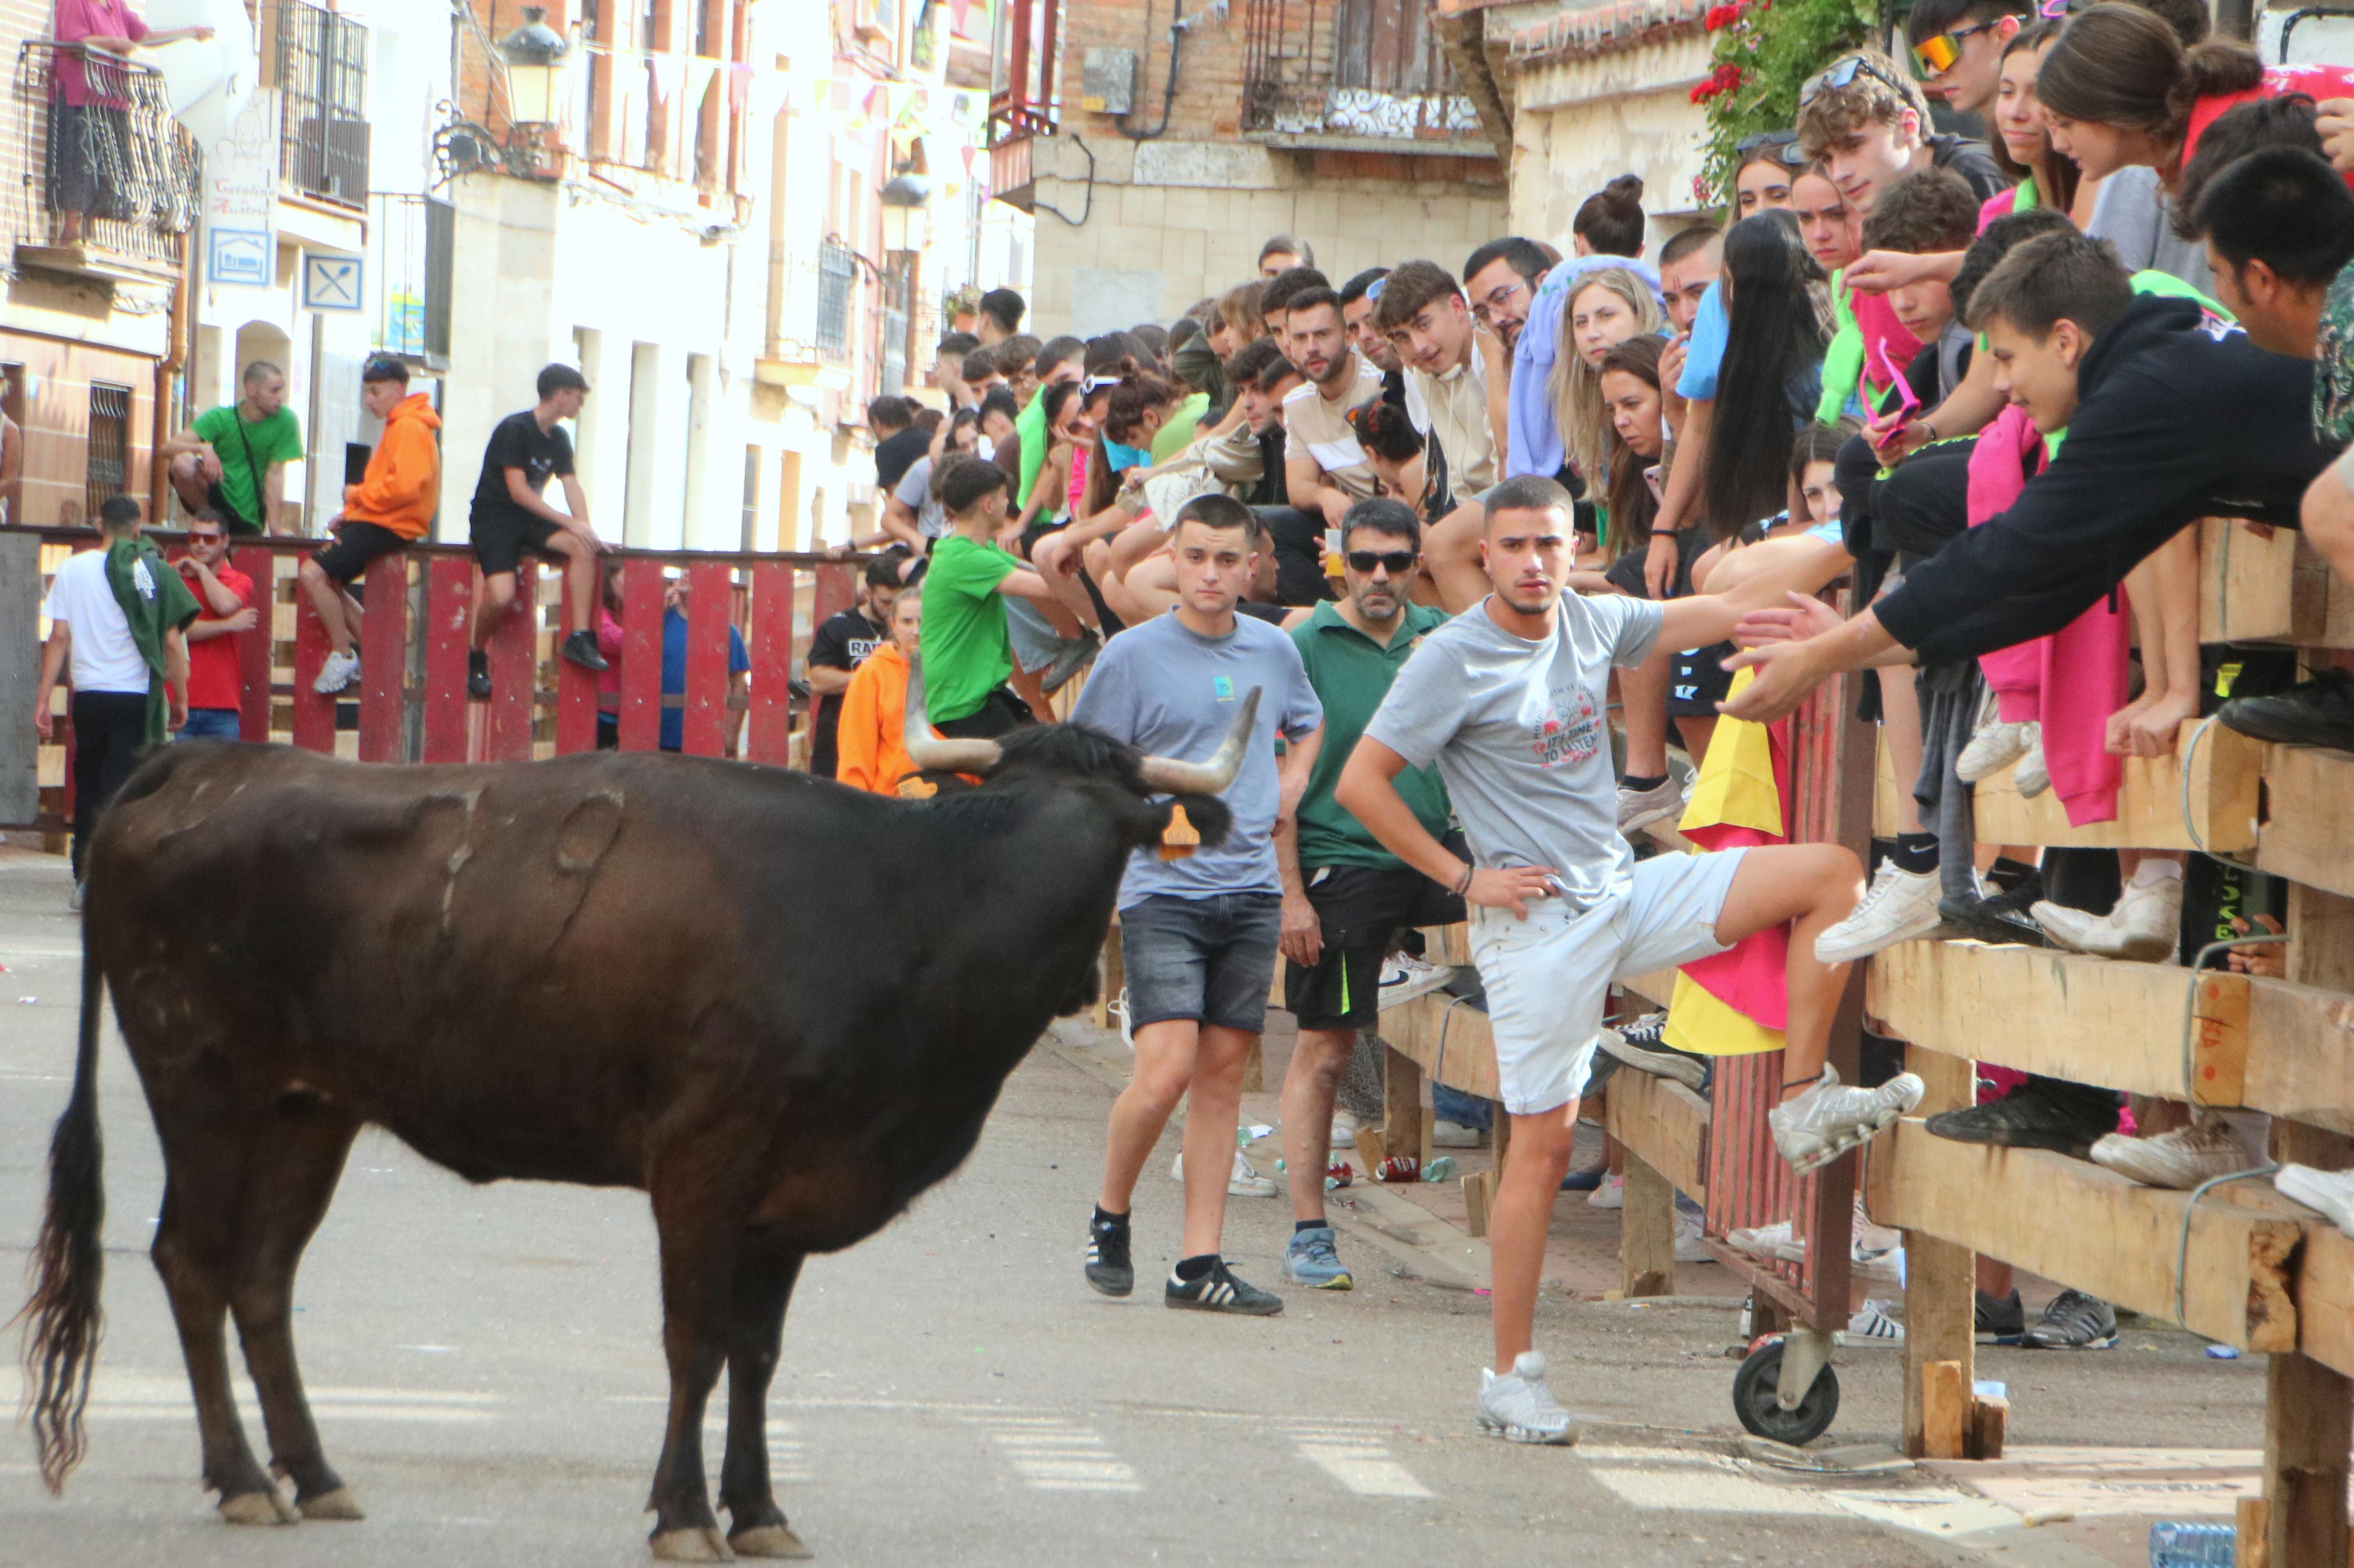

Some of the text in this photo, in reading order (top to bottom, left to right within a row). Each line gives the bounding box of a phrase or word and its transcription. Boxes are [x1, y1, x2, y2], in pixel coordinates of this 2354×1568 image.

[1569, 720, 1592, 738] TIME
[1544, 733, 1597, 763] TO LISTEN
